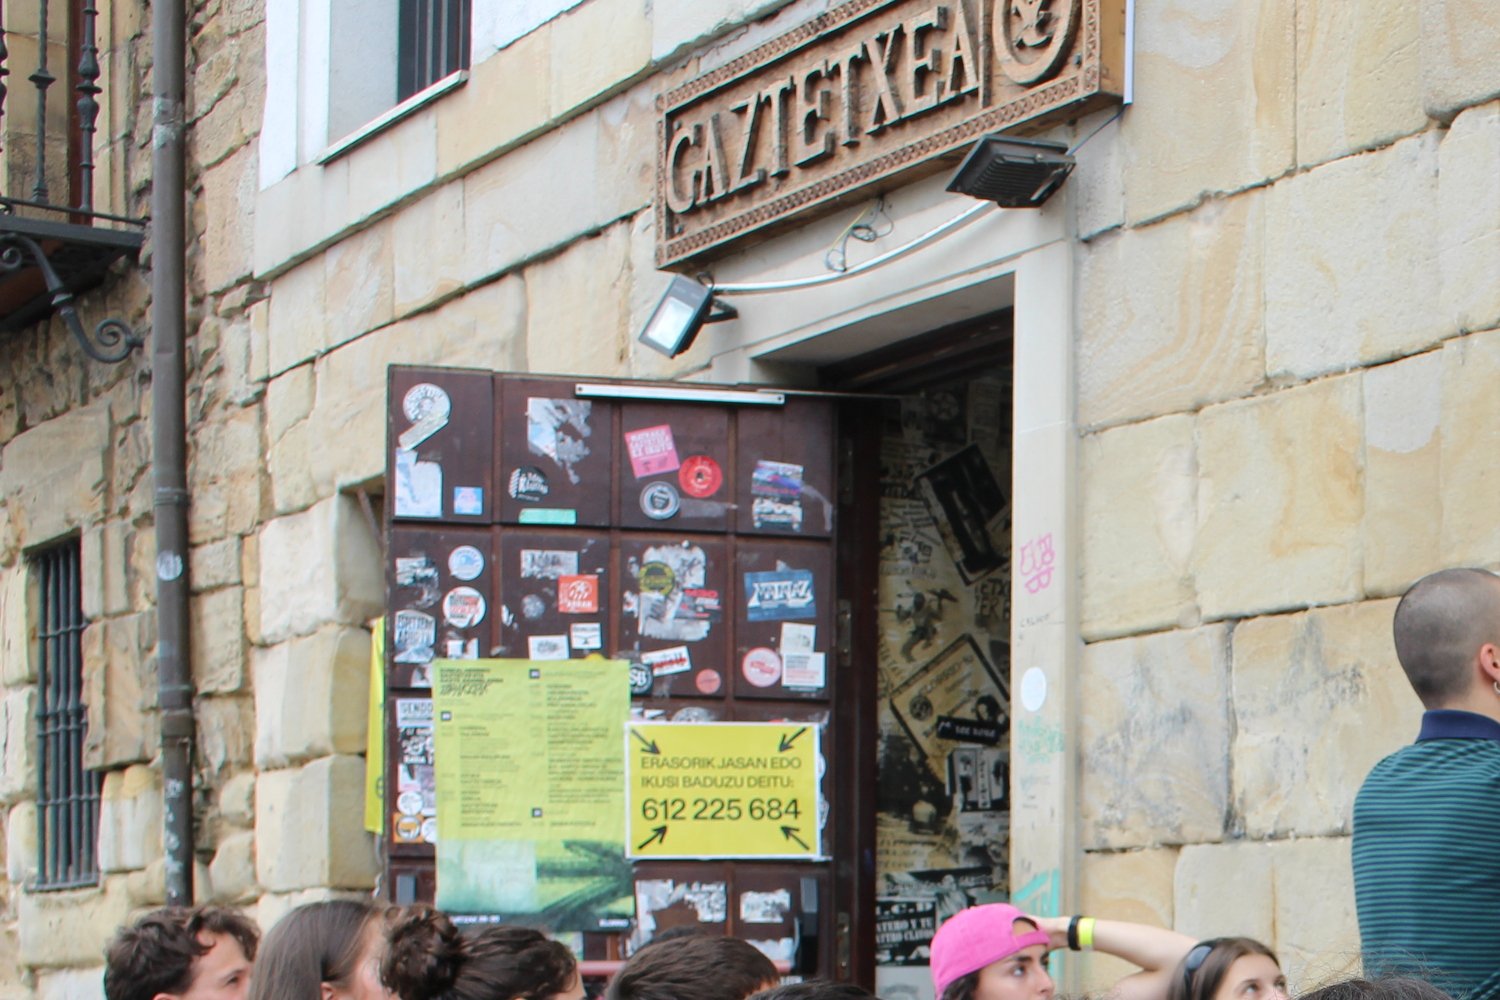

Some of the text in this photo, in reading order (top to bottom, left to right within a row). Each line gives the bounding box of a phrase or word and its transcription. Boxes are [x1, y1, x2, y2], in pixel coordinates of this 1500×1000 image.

[665, 0, 979, 214] GAZTETXEA
[640, 756, 802, 769] ERASORIK JASAN EDO
[640, 775, 795, 788] IKUSI BADUZU DEITU:
[641, 797, 802, 821] 612 225 684
